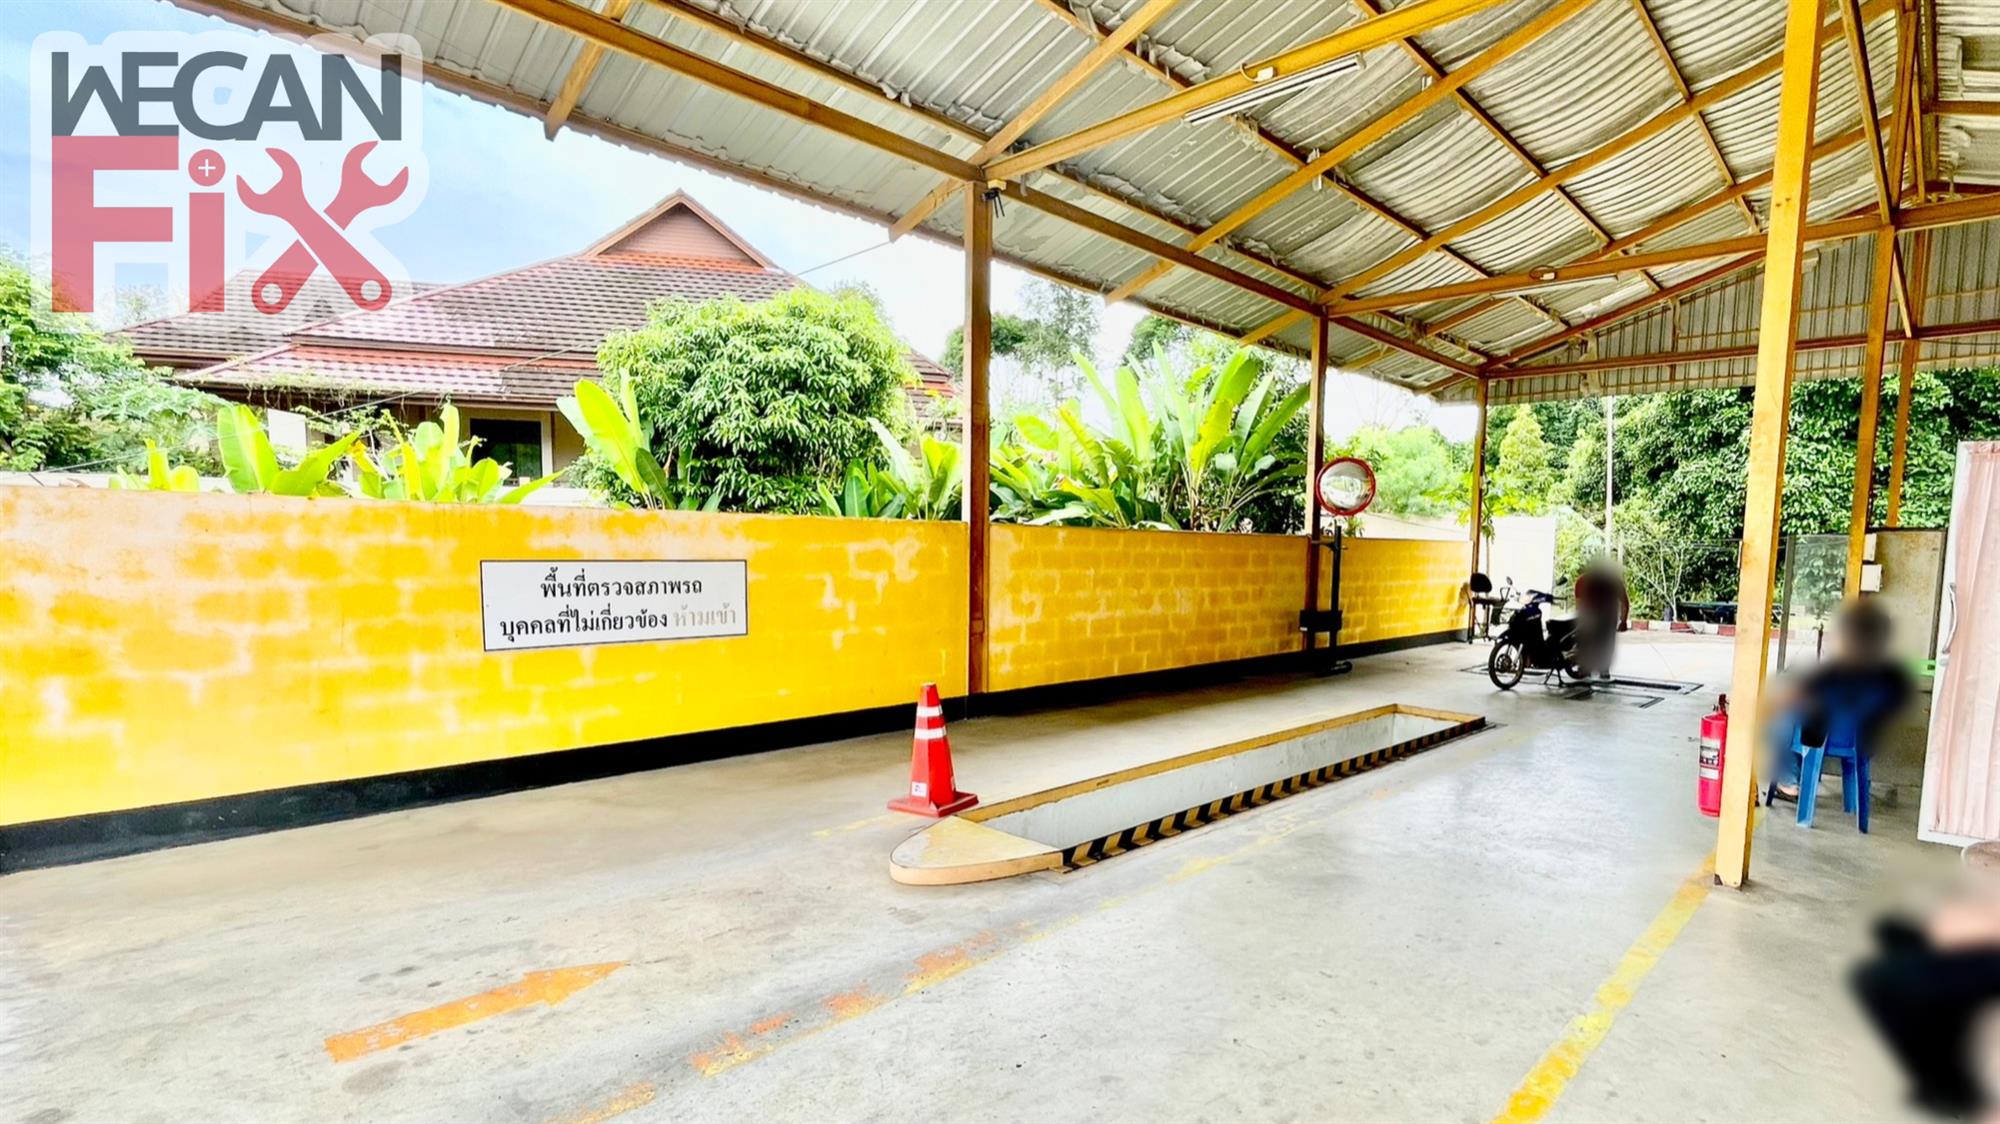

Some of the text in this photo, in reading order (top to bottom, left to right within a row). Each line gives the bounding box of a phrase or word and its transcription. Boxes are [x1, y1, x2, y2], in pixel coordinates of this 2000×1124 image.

[540, 566, 702, 598] พื้นที่ตรวจสภาพรถ
[500, 602, 736, 642] บุคคลที่ไม่เกี่ยวข้อง ห้ามเข้า
